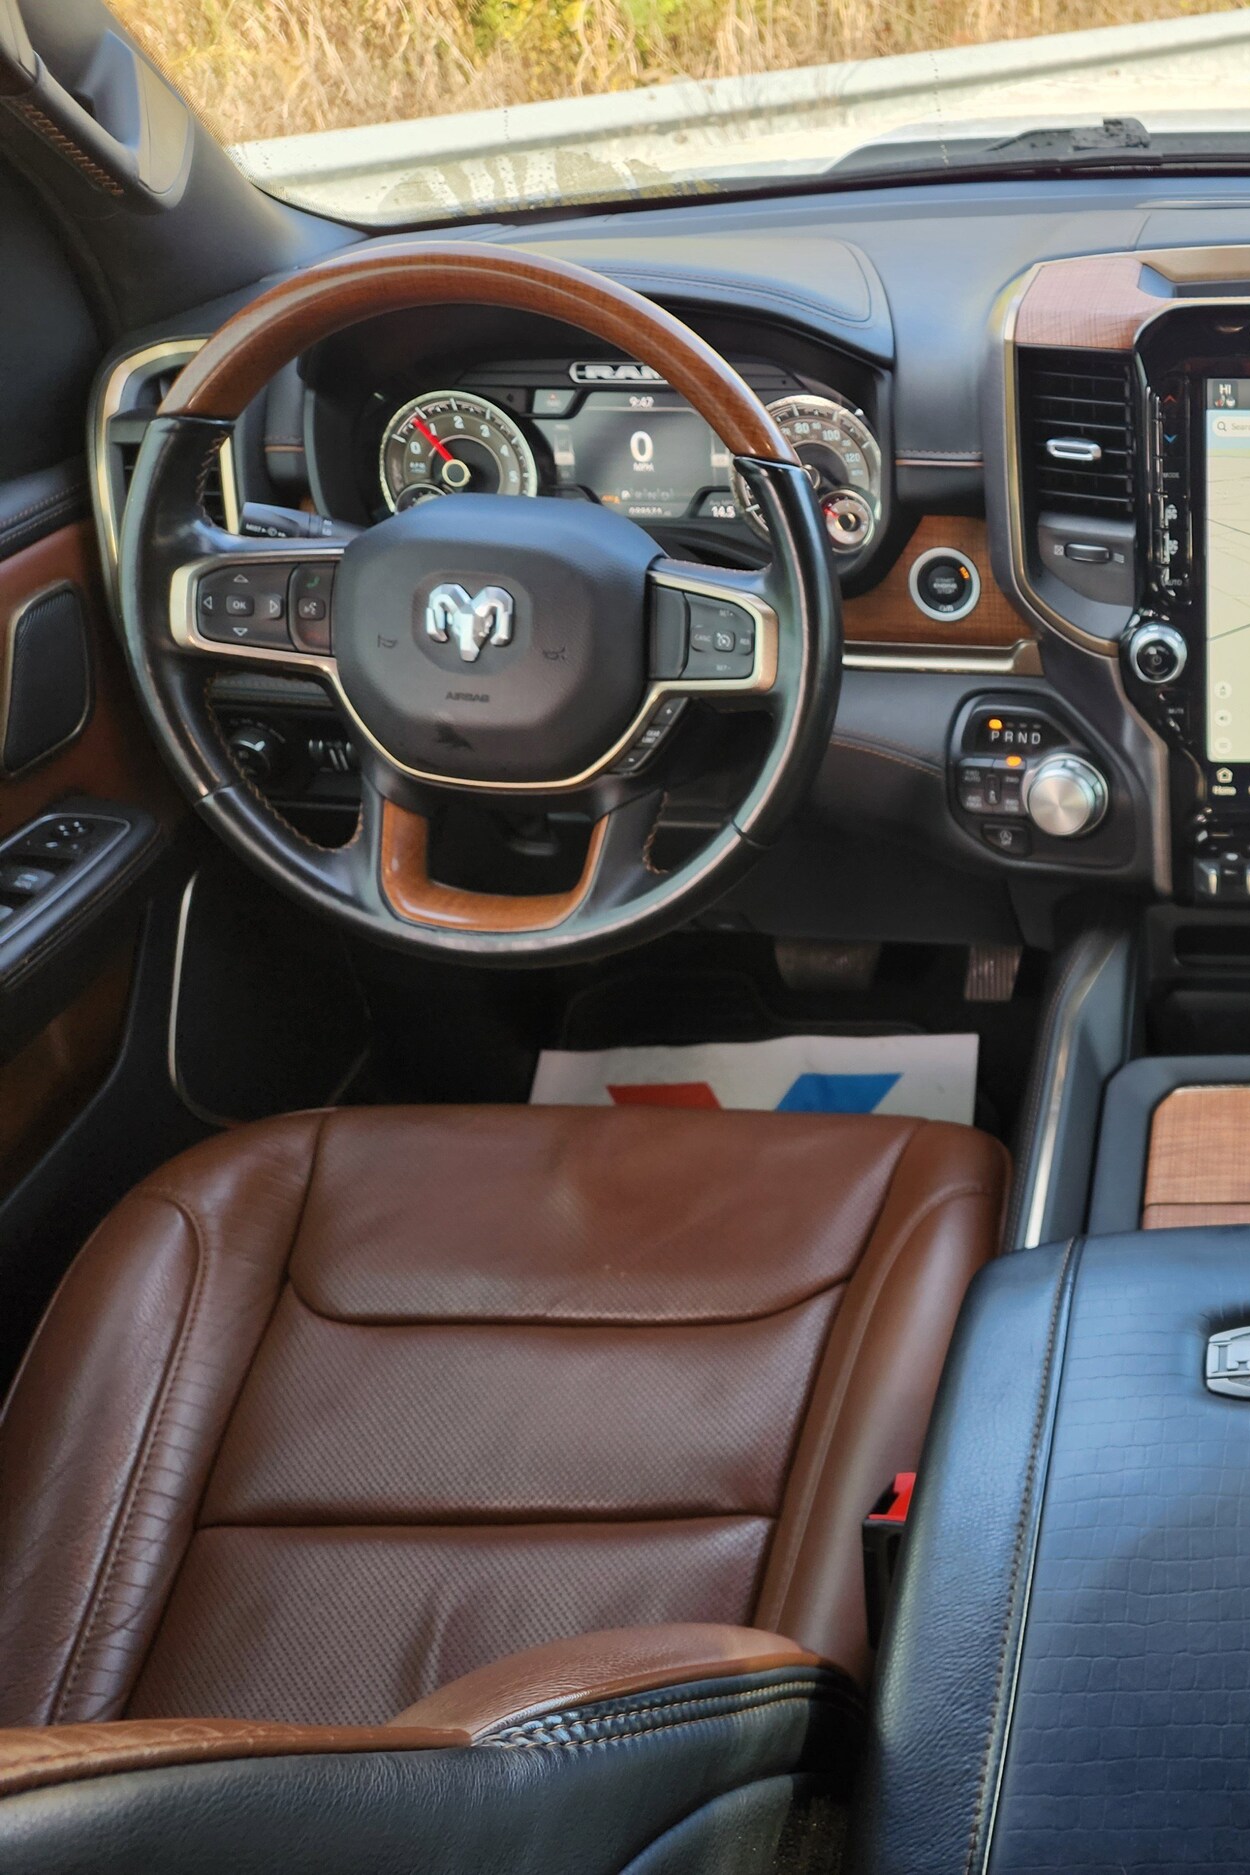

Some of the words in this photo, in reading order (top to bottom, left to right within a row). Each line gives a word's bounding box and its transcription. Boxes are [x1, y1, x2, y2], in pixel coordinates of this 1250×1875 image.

[1219, 384, 1232, 395] HI
[453, 415, 465, 429] 2
[794, 422, 811, 434] 80
[480, 424, 490, 437] 3
[822, 429, 840, 442] 100
[630, 430, 654, 463] 0
[844, 453, 861, 463] 120
[232, 601, 247, 609] OK
